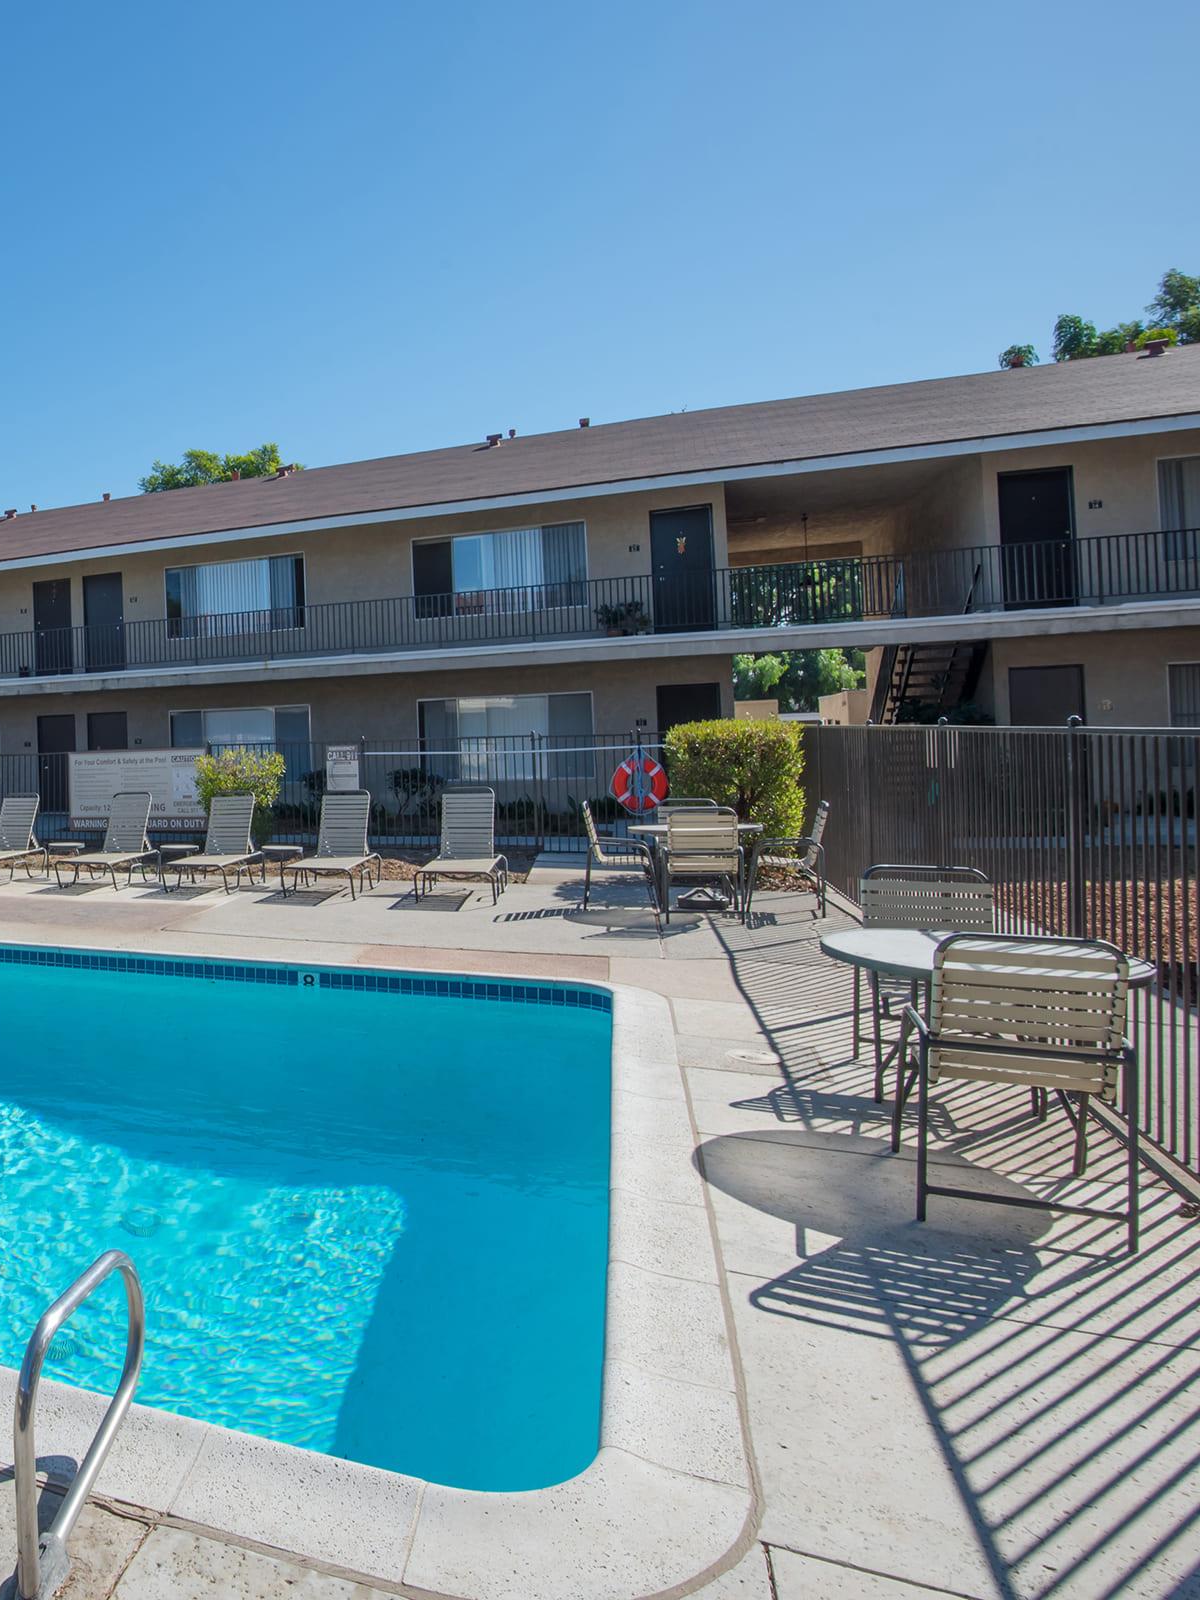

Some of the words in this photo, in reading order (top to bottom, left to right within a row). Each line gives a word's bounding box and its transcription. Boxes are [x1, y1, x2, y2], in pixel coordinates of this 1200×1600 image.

[327, 751, 345, 760] CALL
[347, 751, 358, 760] 911
[122, 757, 138, 766] Safety
[72, 819, 108, 828] WARNING
[170, 819, 182, 828] ON
[183, 818, 205, 828] DUTY
